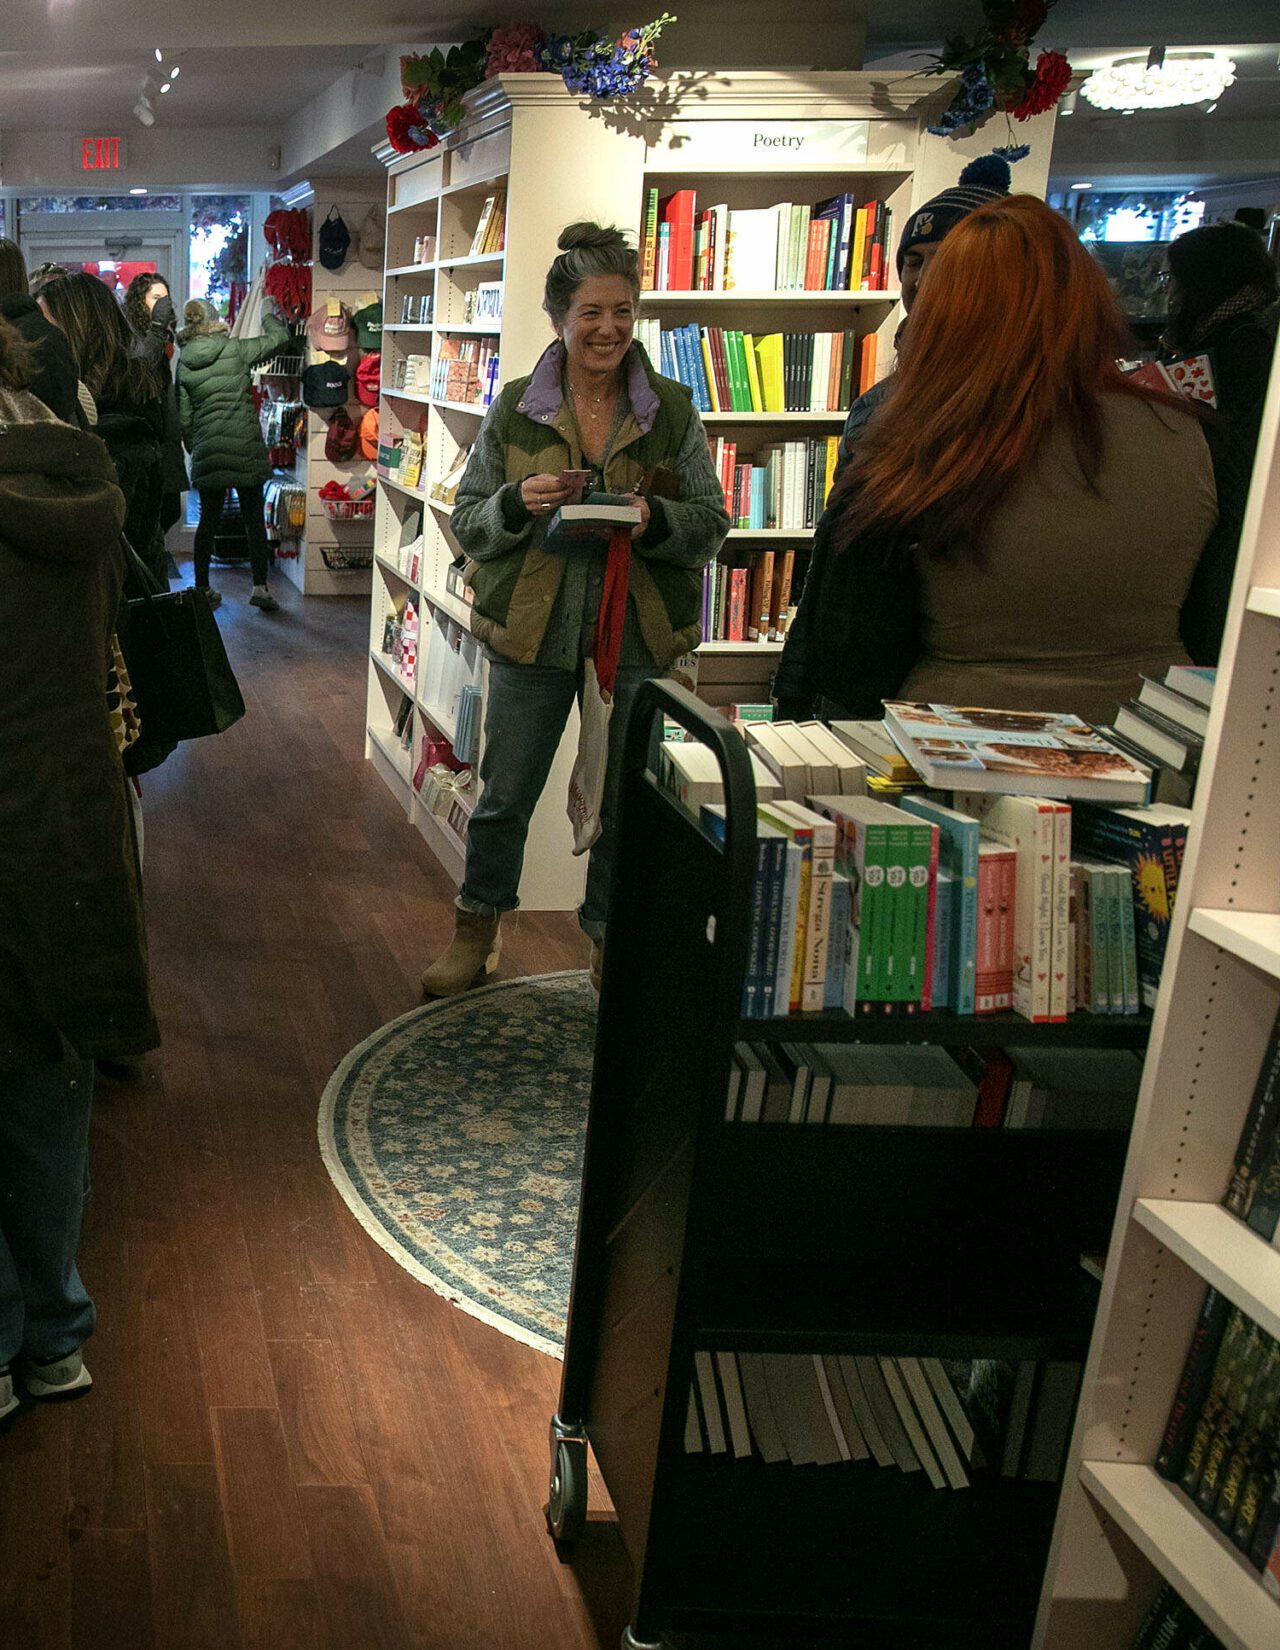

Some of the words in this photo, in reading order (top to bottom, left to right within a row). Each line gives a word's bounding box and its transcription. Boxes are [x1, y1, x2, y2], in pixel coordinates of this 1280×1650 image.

[753, 133, 805, 150] Poetry
[82, 137, 120, 169] EXIT
[1040, 873, 1049, 894] Good
[1058, 873, 1067, 894] Good
[814, 881, 826, 932] Strega
[1038, 928, 1046, 948] Love
[1056, 928, 1064, 948] Love
[812, 938, 824, 979] Nona
[1055, 949, 1063, 963] You
